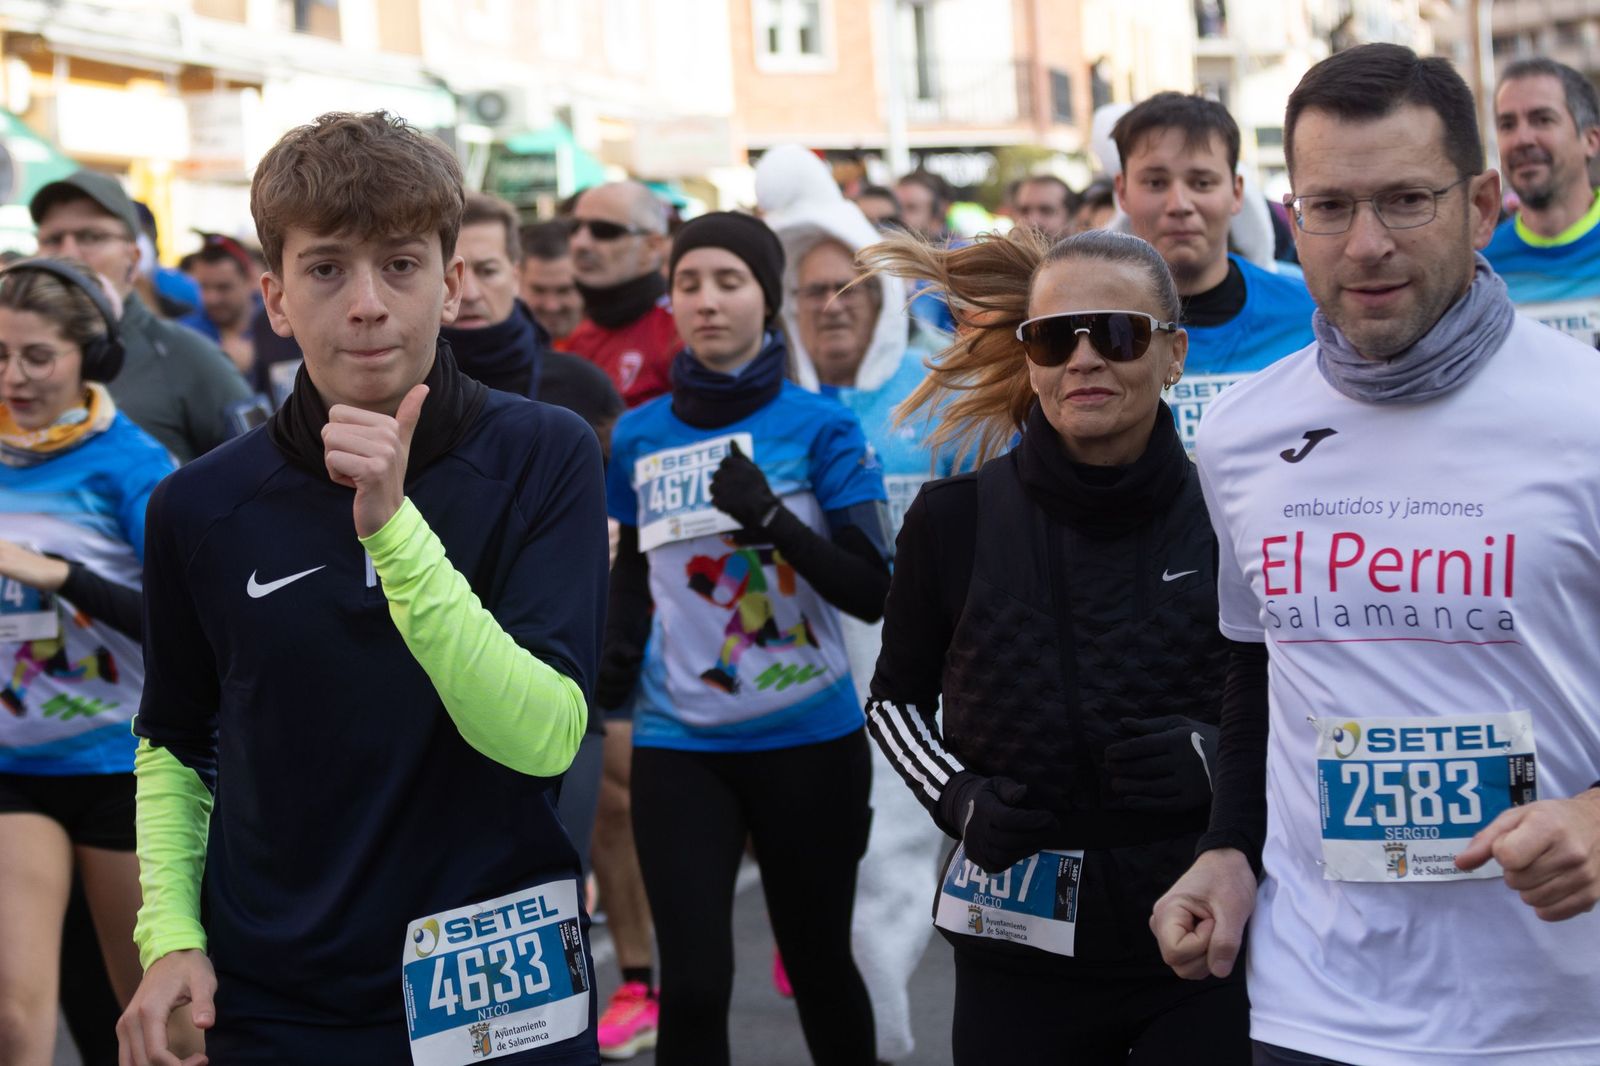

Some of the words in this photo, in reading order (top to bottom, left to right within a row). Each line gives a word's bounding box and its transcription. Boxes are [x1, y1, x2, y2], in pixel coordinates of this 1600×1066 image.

[1174, 382, 1236, 398] SET
[1283, 497, 1383, 518] embutidos
[1388, 500, 1400, 518] y
[1402, 497, 1484, 519] jamones
[1262, 531, 1304, 596] El
[1328, 532, 1515, 598] Pernil
[1265, 596, 1514, 632] Salamanca
[1367, 724, 1512, 753] SETEL
[1341, 760, 1482, 827] 2583
[1385, 827, 1440, 840] SERGIO
[1413, 866, 1423, 875] de
[973, 893, 1002, 909] ROCIO
[444, 895, 559, 944] SETEL
[985, 917, 1027, 932] Ayuntamiento
[986, 927, 994, 935] de
[995, 927, 1028, 941] Salamanca
[429, 932, 551, 1016] 4633
[478, 1003, 510, 1021] NICO
[494, 1020, 547, 1040] Ayuntamiento
[496, 1039, 507, 1051] de
[508, 1031, 549, 1049] Salamanca
